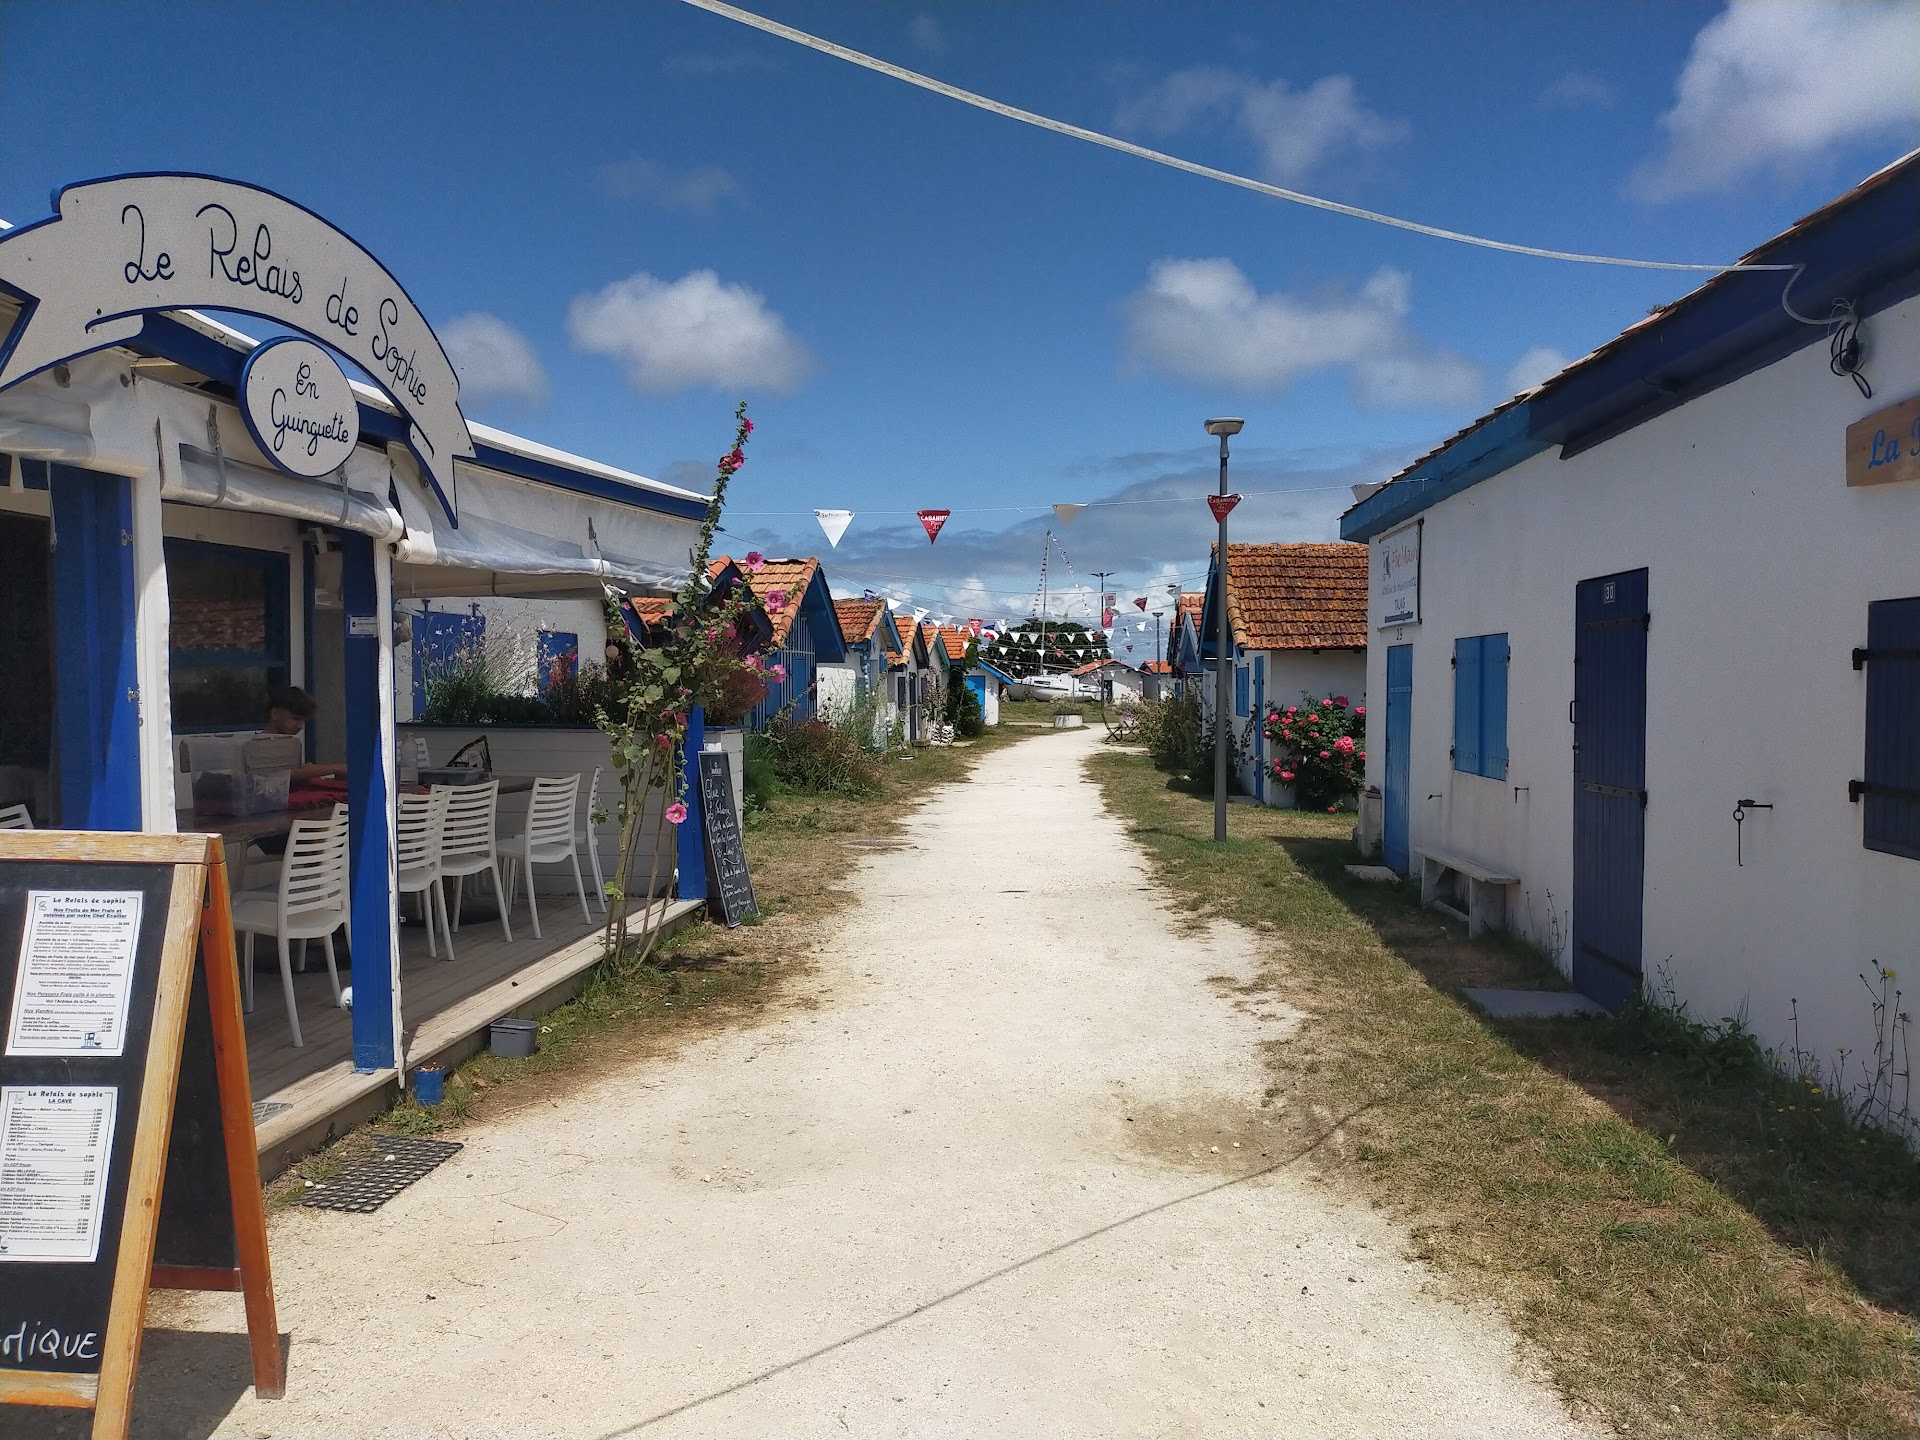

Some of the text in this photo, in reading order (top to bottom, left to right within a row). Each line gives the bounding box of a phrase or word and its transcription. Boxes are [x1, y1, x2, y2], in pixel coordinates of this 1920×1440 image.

[121, 203, 427, 406] Le Relais de Sophie
[295, 361, 320, 400] En
[271, 388, 350, 457] Guinguette
[1867, 428, 1901, 470] La
[1605, 586, 1614, 600] 30
